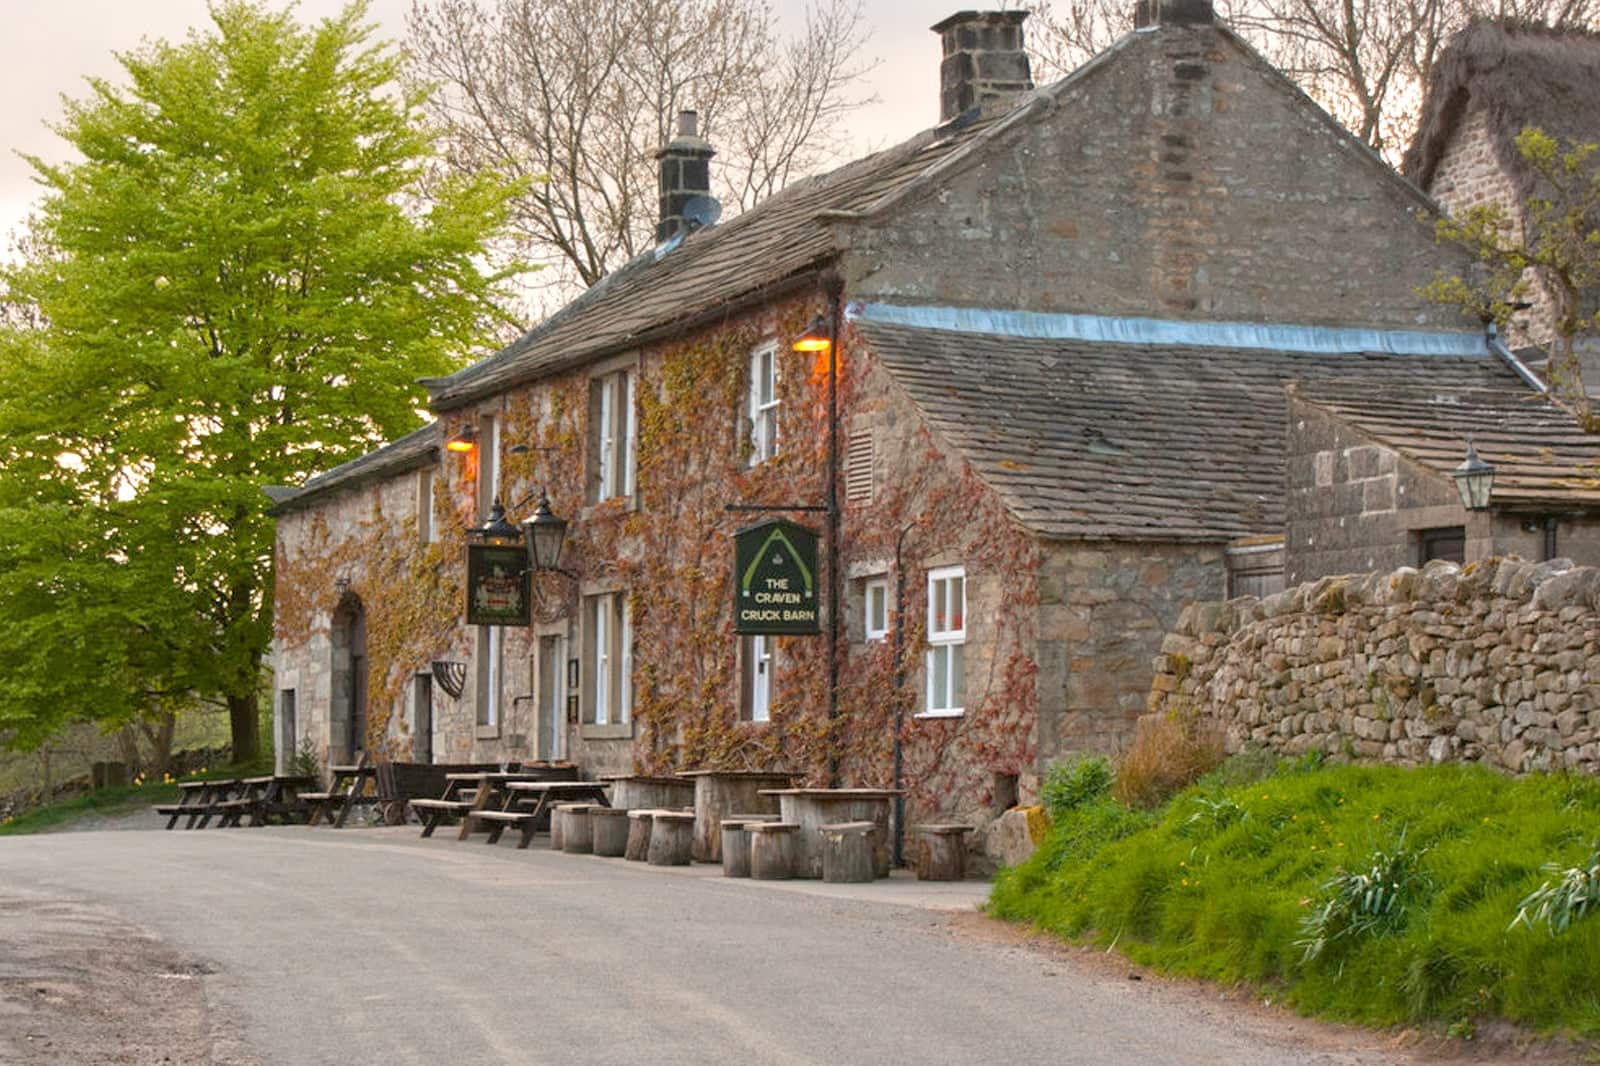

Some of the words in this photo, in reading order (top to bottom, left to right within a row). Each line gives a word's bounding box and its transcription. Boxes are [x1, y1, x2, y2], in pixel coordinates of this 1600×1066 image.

[766, 578, 789, 590] THE
[755, 592, 801, 604] CRAVEN
[741, 610, 781, 621] CRUCK
[783, 610, 815, 621] BARN
